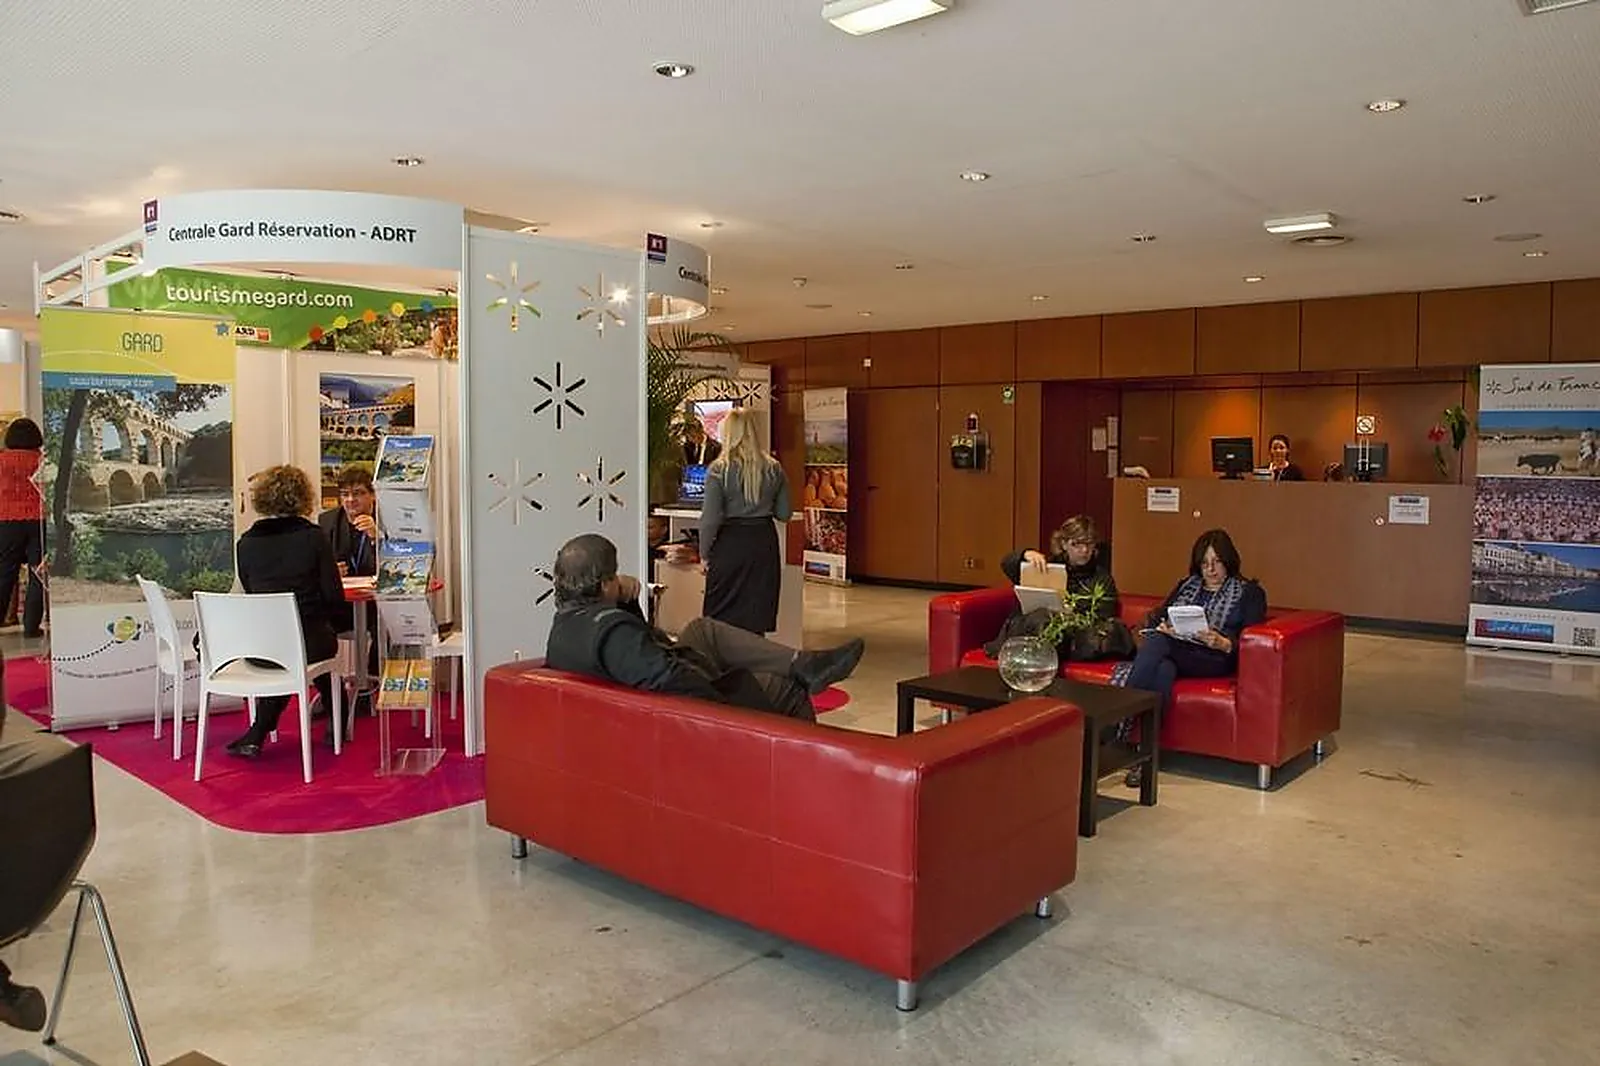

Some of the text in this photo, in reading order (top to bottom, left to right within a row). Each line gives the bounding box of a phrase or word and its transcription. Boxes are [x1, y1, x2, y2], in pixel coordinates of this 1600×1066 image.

[168, 223, 216, 241] Centrale
[218, 220, 254, 238] Gard
[258, 221, 356, 239] Réservation
[370, 226, 417, 243] ADRT
[166, 284, 353, 308] tourismegard.com
[122, 332, 163, 353] GARD
[1502, 376, 1533, 395] Sud
[1537, 380, 1552, 391] de
